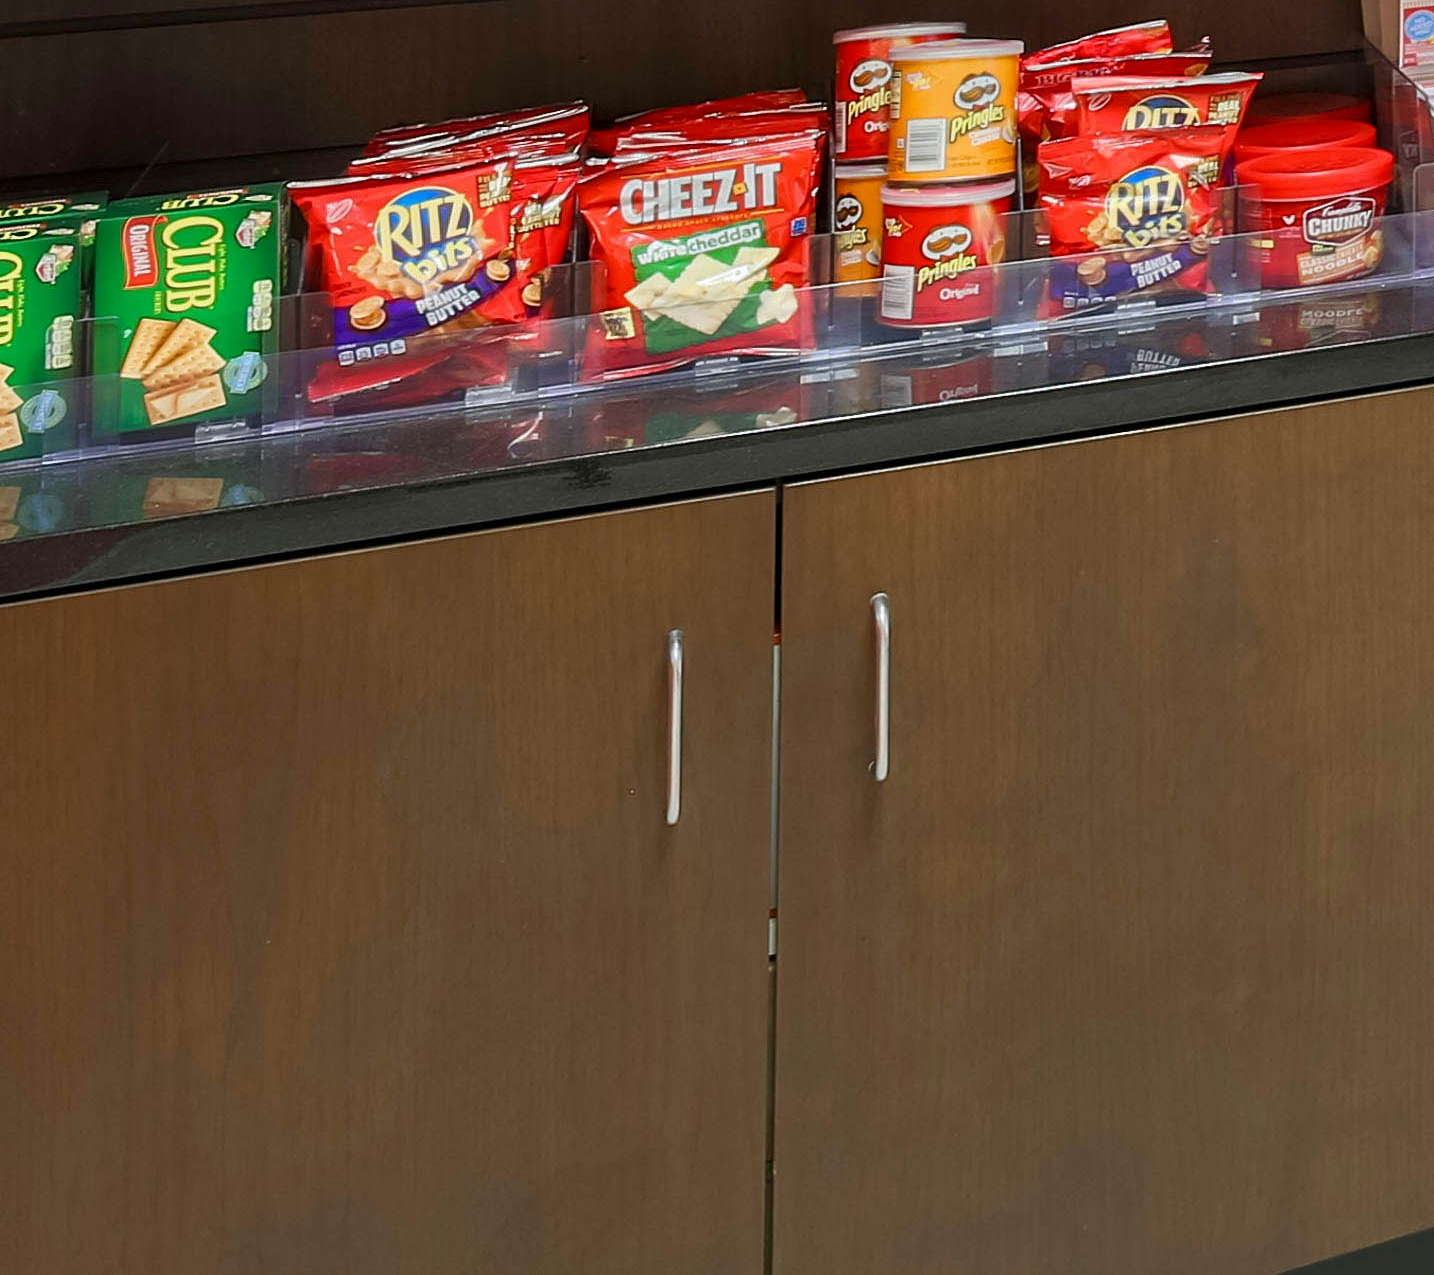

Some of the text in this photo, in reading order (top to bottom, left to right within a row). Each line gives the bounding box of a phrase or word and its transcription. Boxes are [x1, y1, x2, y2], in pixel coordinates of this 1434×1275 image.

[949, 102, 1006, 144] Pringles
[1104, 173, 1185, 230] RITZ
[377, 193, 467, 269] RITZ
[689, 224, 762, 255] cheddar
[1307, 209, 1373, 237] CHUNKY
[129, 223, 151, 278] ORIGINAL
[162, 216, 226, 313] CLUB
[1129, 253, 1174, 277] PEANUT
[917, 252, 977, 293] Pringles
[1136, 260, 1183, 289] BUTTER
[414, 282, 470, 315] PEANUT
[425, 291, 482, 327] BUTTER
